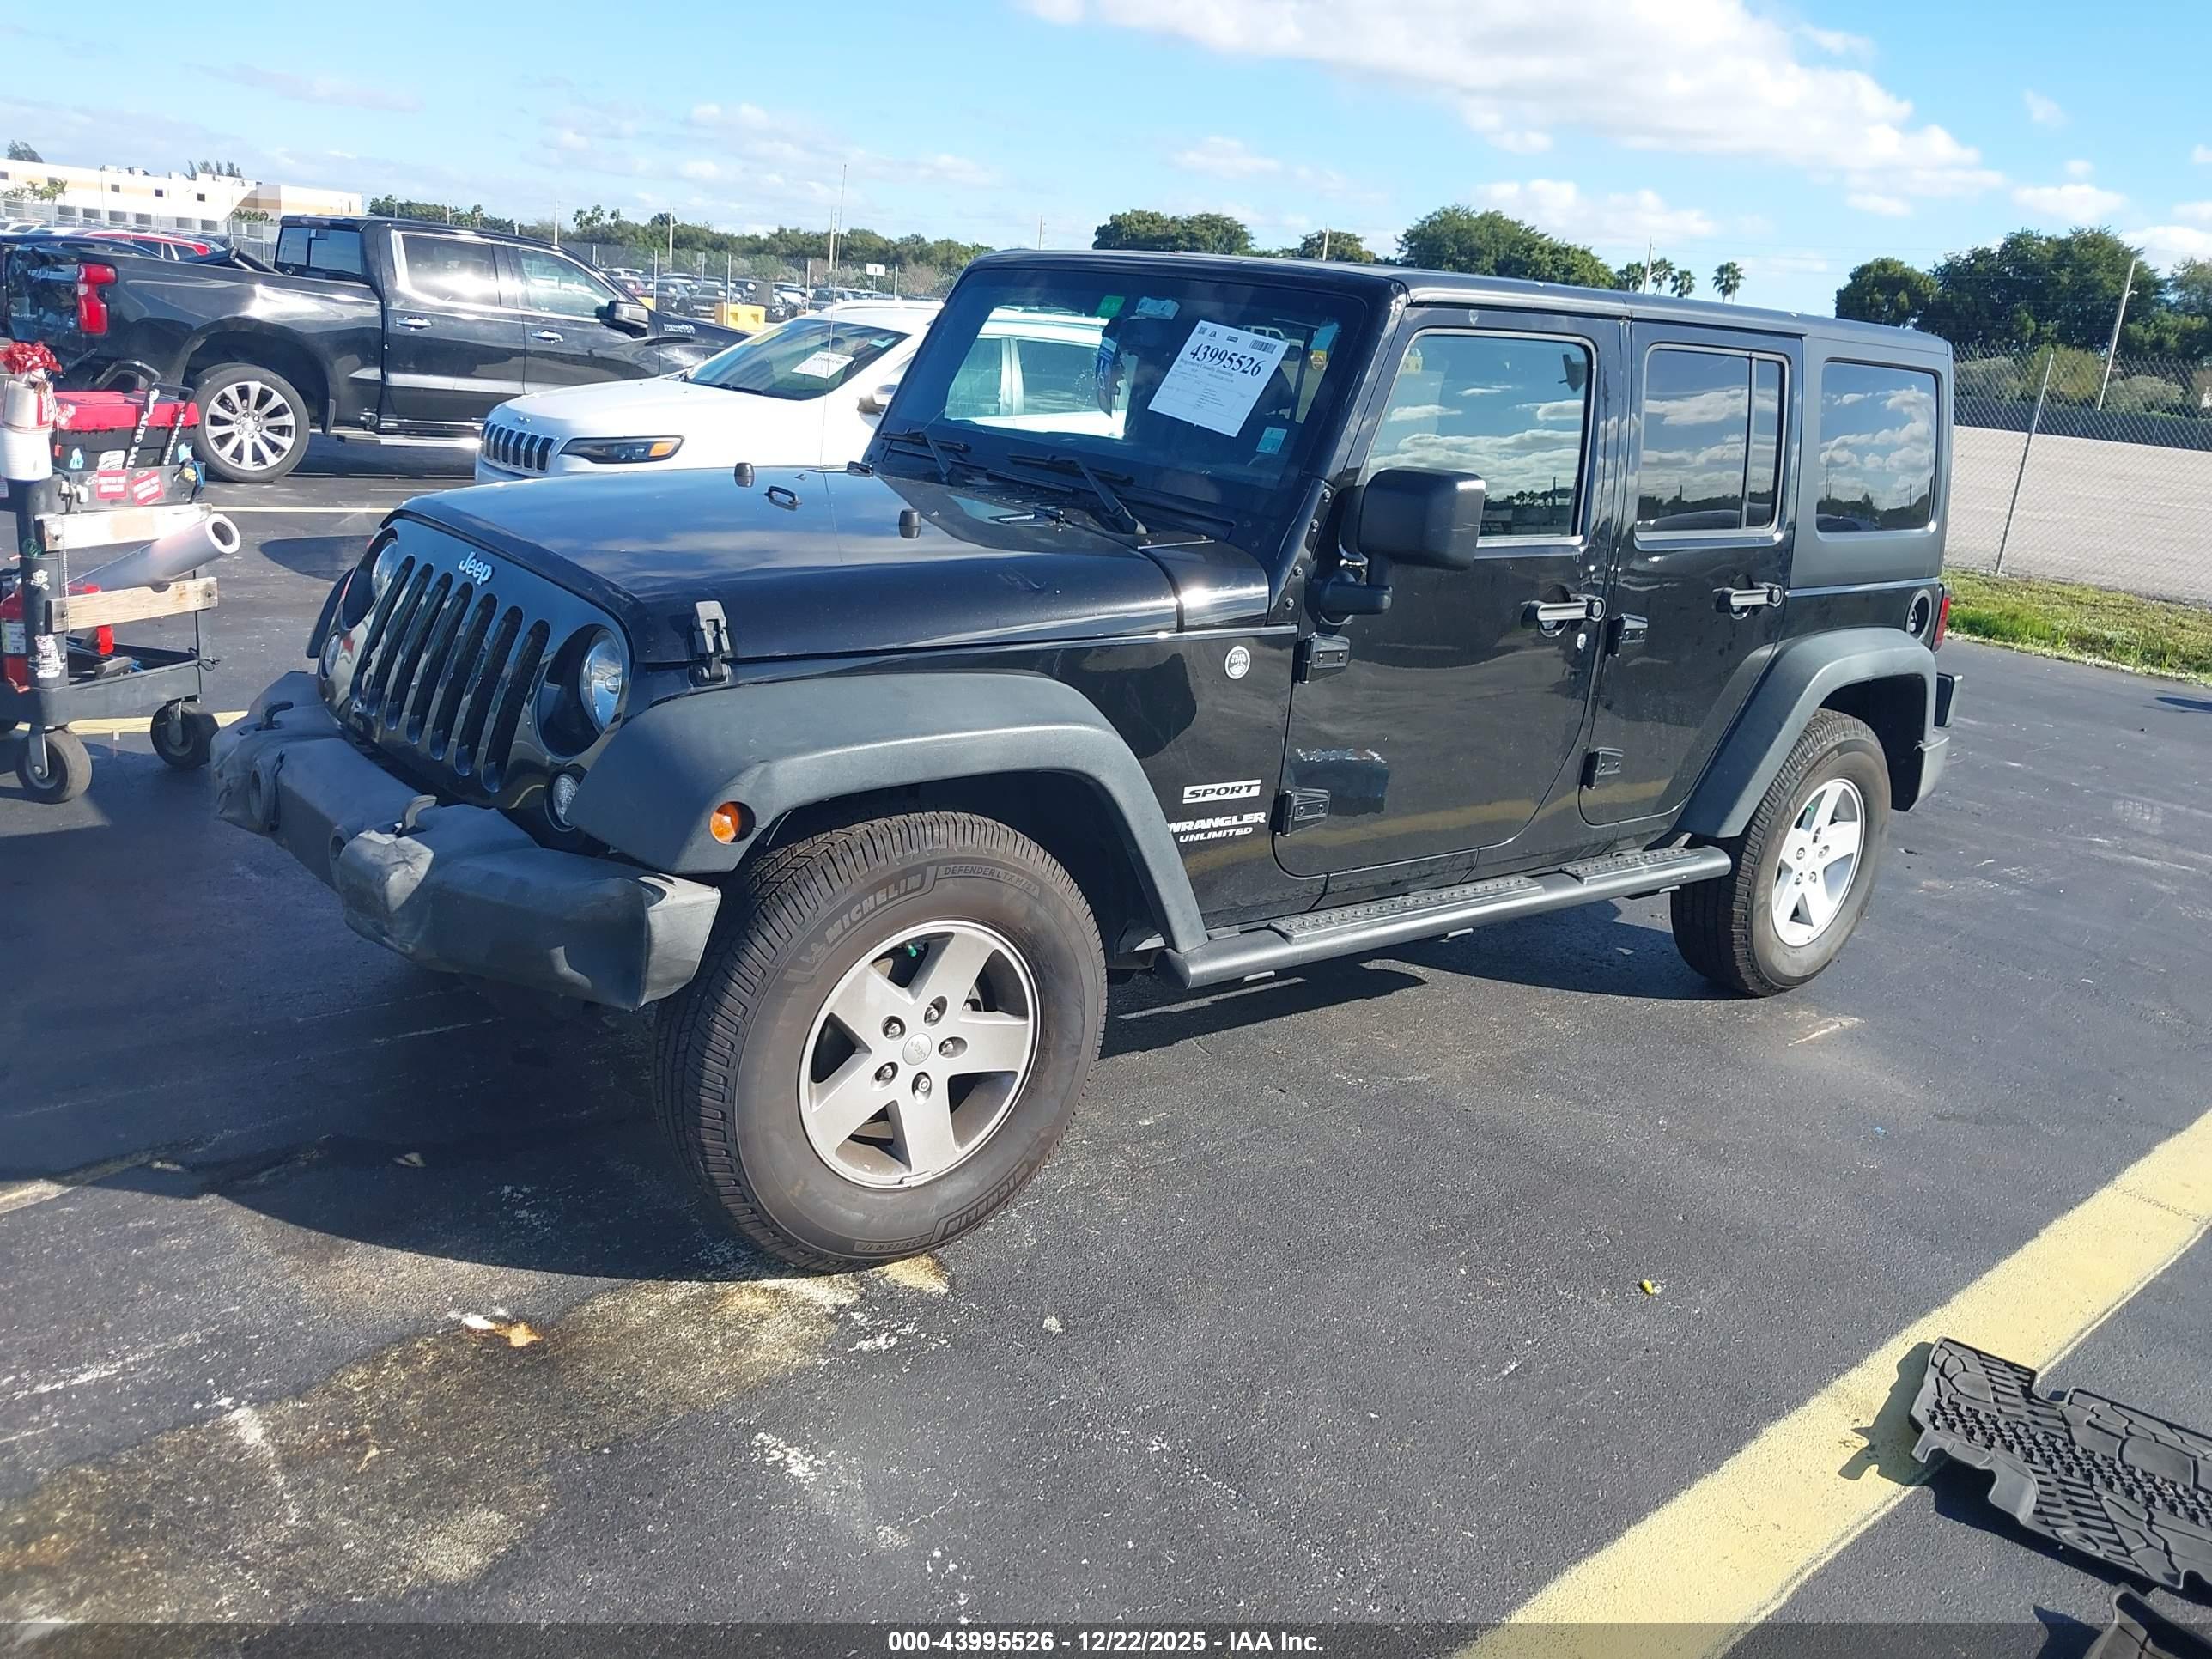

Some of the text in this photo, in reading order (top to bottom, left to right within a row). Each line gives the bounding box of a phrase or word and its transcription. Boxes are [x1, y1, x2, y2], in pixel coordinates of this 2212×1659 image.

[1190, 343, 1267, 377] 43995526
[458, 551, 494, 586] Jeep
[1188, 785, 1255, 799] SPORT
[1168, 811, 1267, 833] WRANGLER
[1179, 827, 1253, 842] UNLIMITED
[825, 872, 922, 943] MICHELIN
[945, 866, 996, 877] DEFENDER
